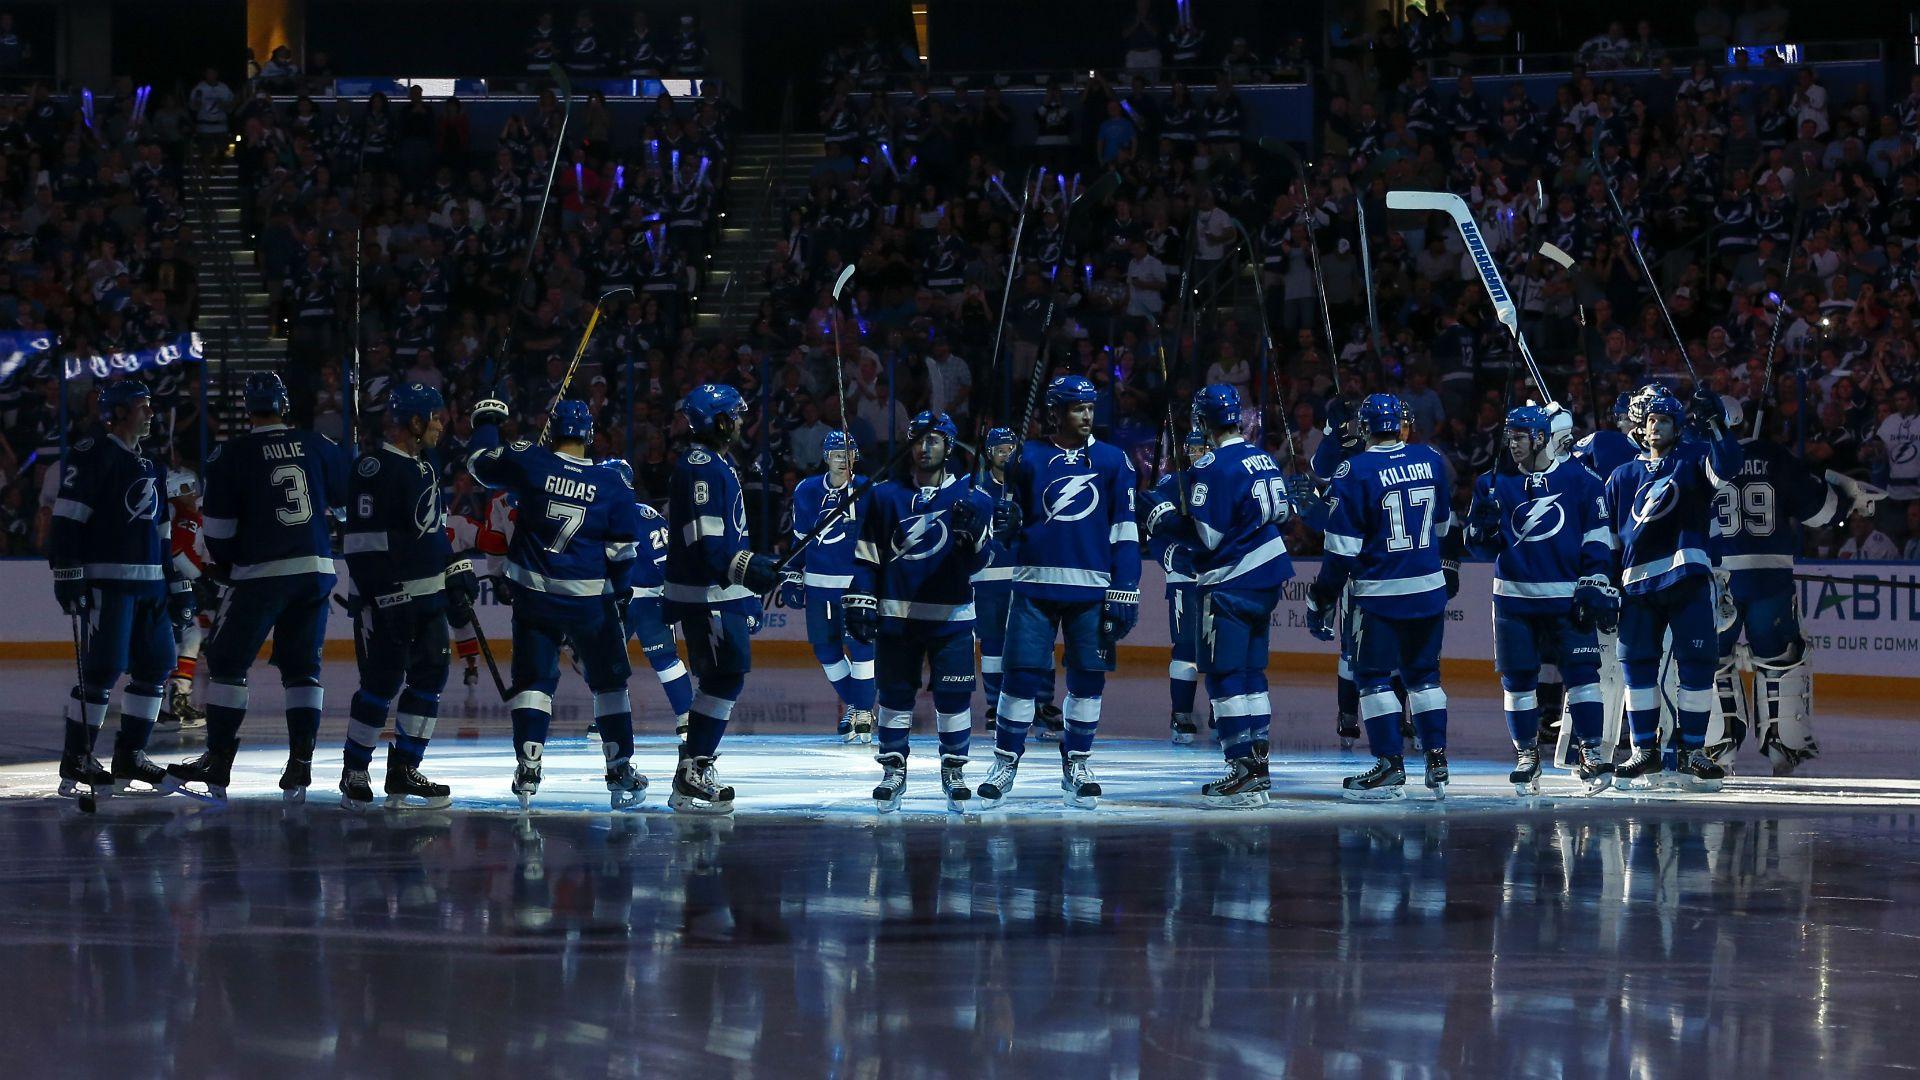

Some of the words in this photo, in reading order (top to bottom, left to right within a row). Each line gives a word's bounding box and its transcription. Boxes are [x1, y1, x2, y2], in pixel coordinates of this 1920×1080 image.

[1461, 221, 1508, 302] WARRIOR
[568, 426, 574, 434] 7
[262, 441, 306, 461] AULIE
[1378, 462, 1434, 488] KILLORN
[270, 464, 313, 526] 3
[545, 475, 598, 503] GUDAS
[694, 480, 709, 506] 8
[1190, 482, 1209, 507] 6
[1251, 476, 1290, 526] 16
[357, 492, 374, 519] 6
[1381, 485, 1436, 553] 17
[1711, 481, 1776, 537] 39
[546, 499, 587, 554] 7
[1838, 637, 1868, 650] OUR
